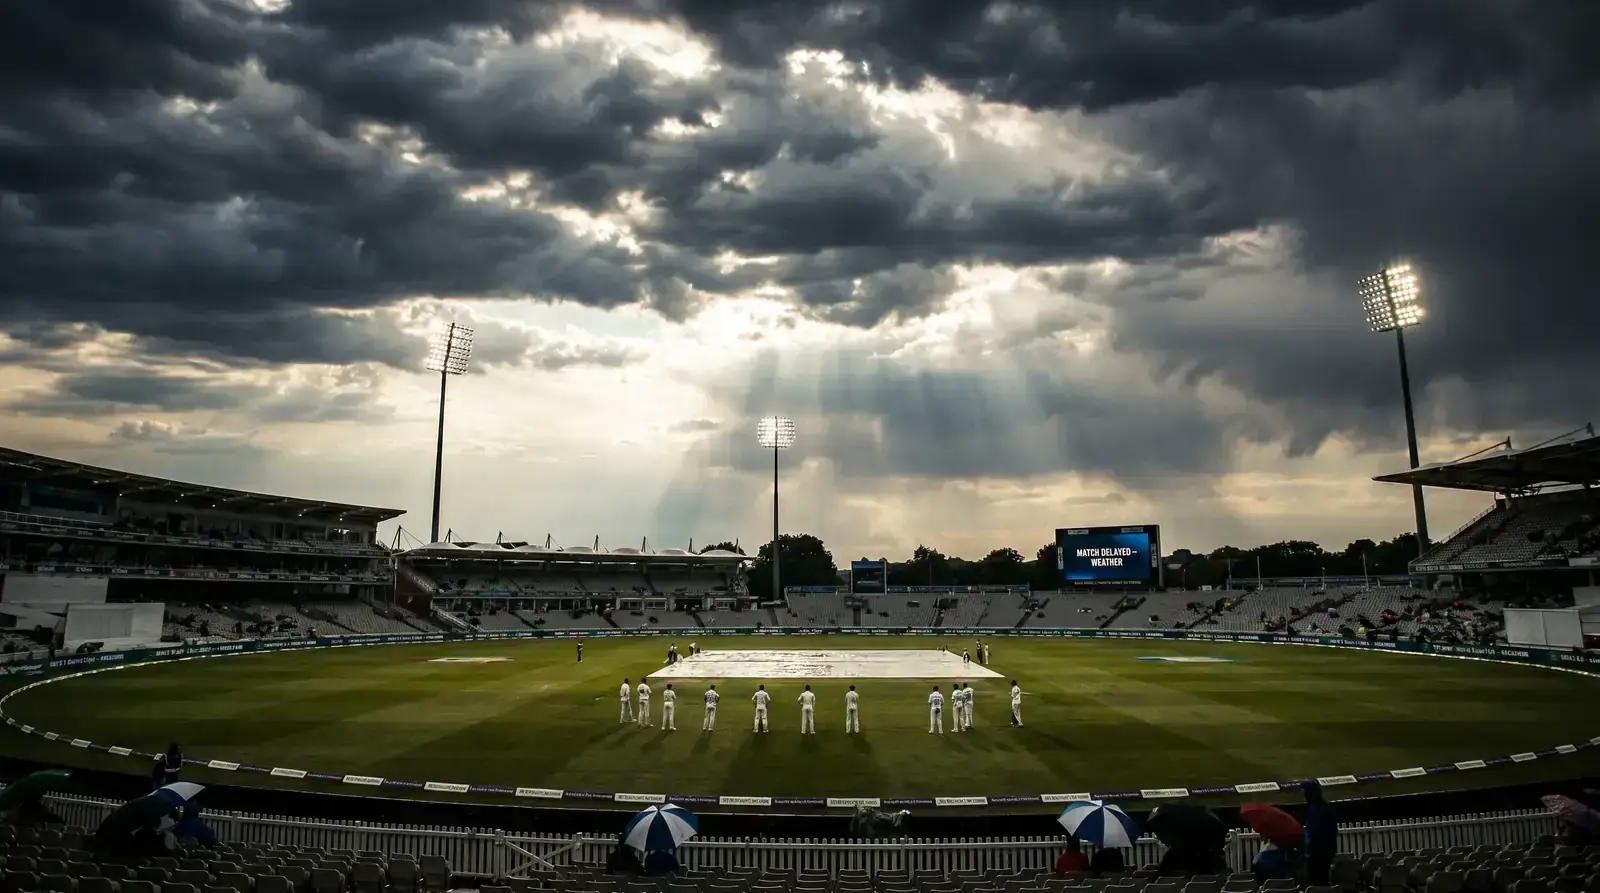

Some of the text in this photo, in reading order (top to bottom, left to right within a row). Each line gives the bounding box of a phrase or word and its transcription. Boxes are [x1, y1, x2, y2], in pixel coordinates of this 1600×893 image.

[1077, 548, 1099, 557] MATCH
[1101, 547, 1131, 556] DELAYED
[1091, 558, 1123, 566] WEATHER
